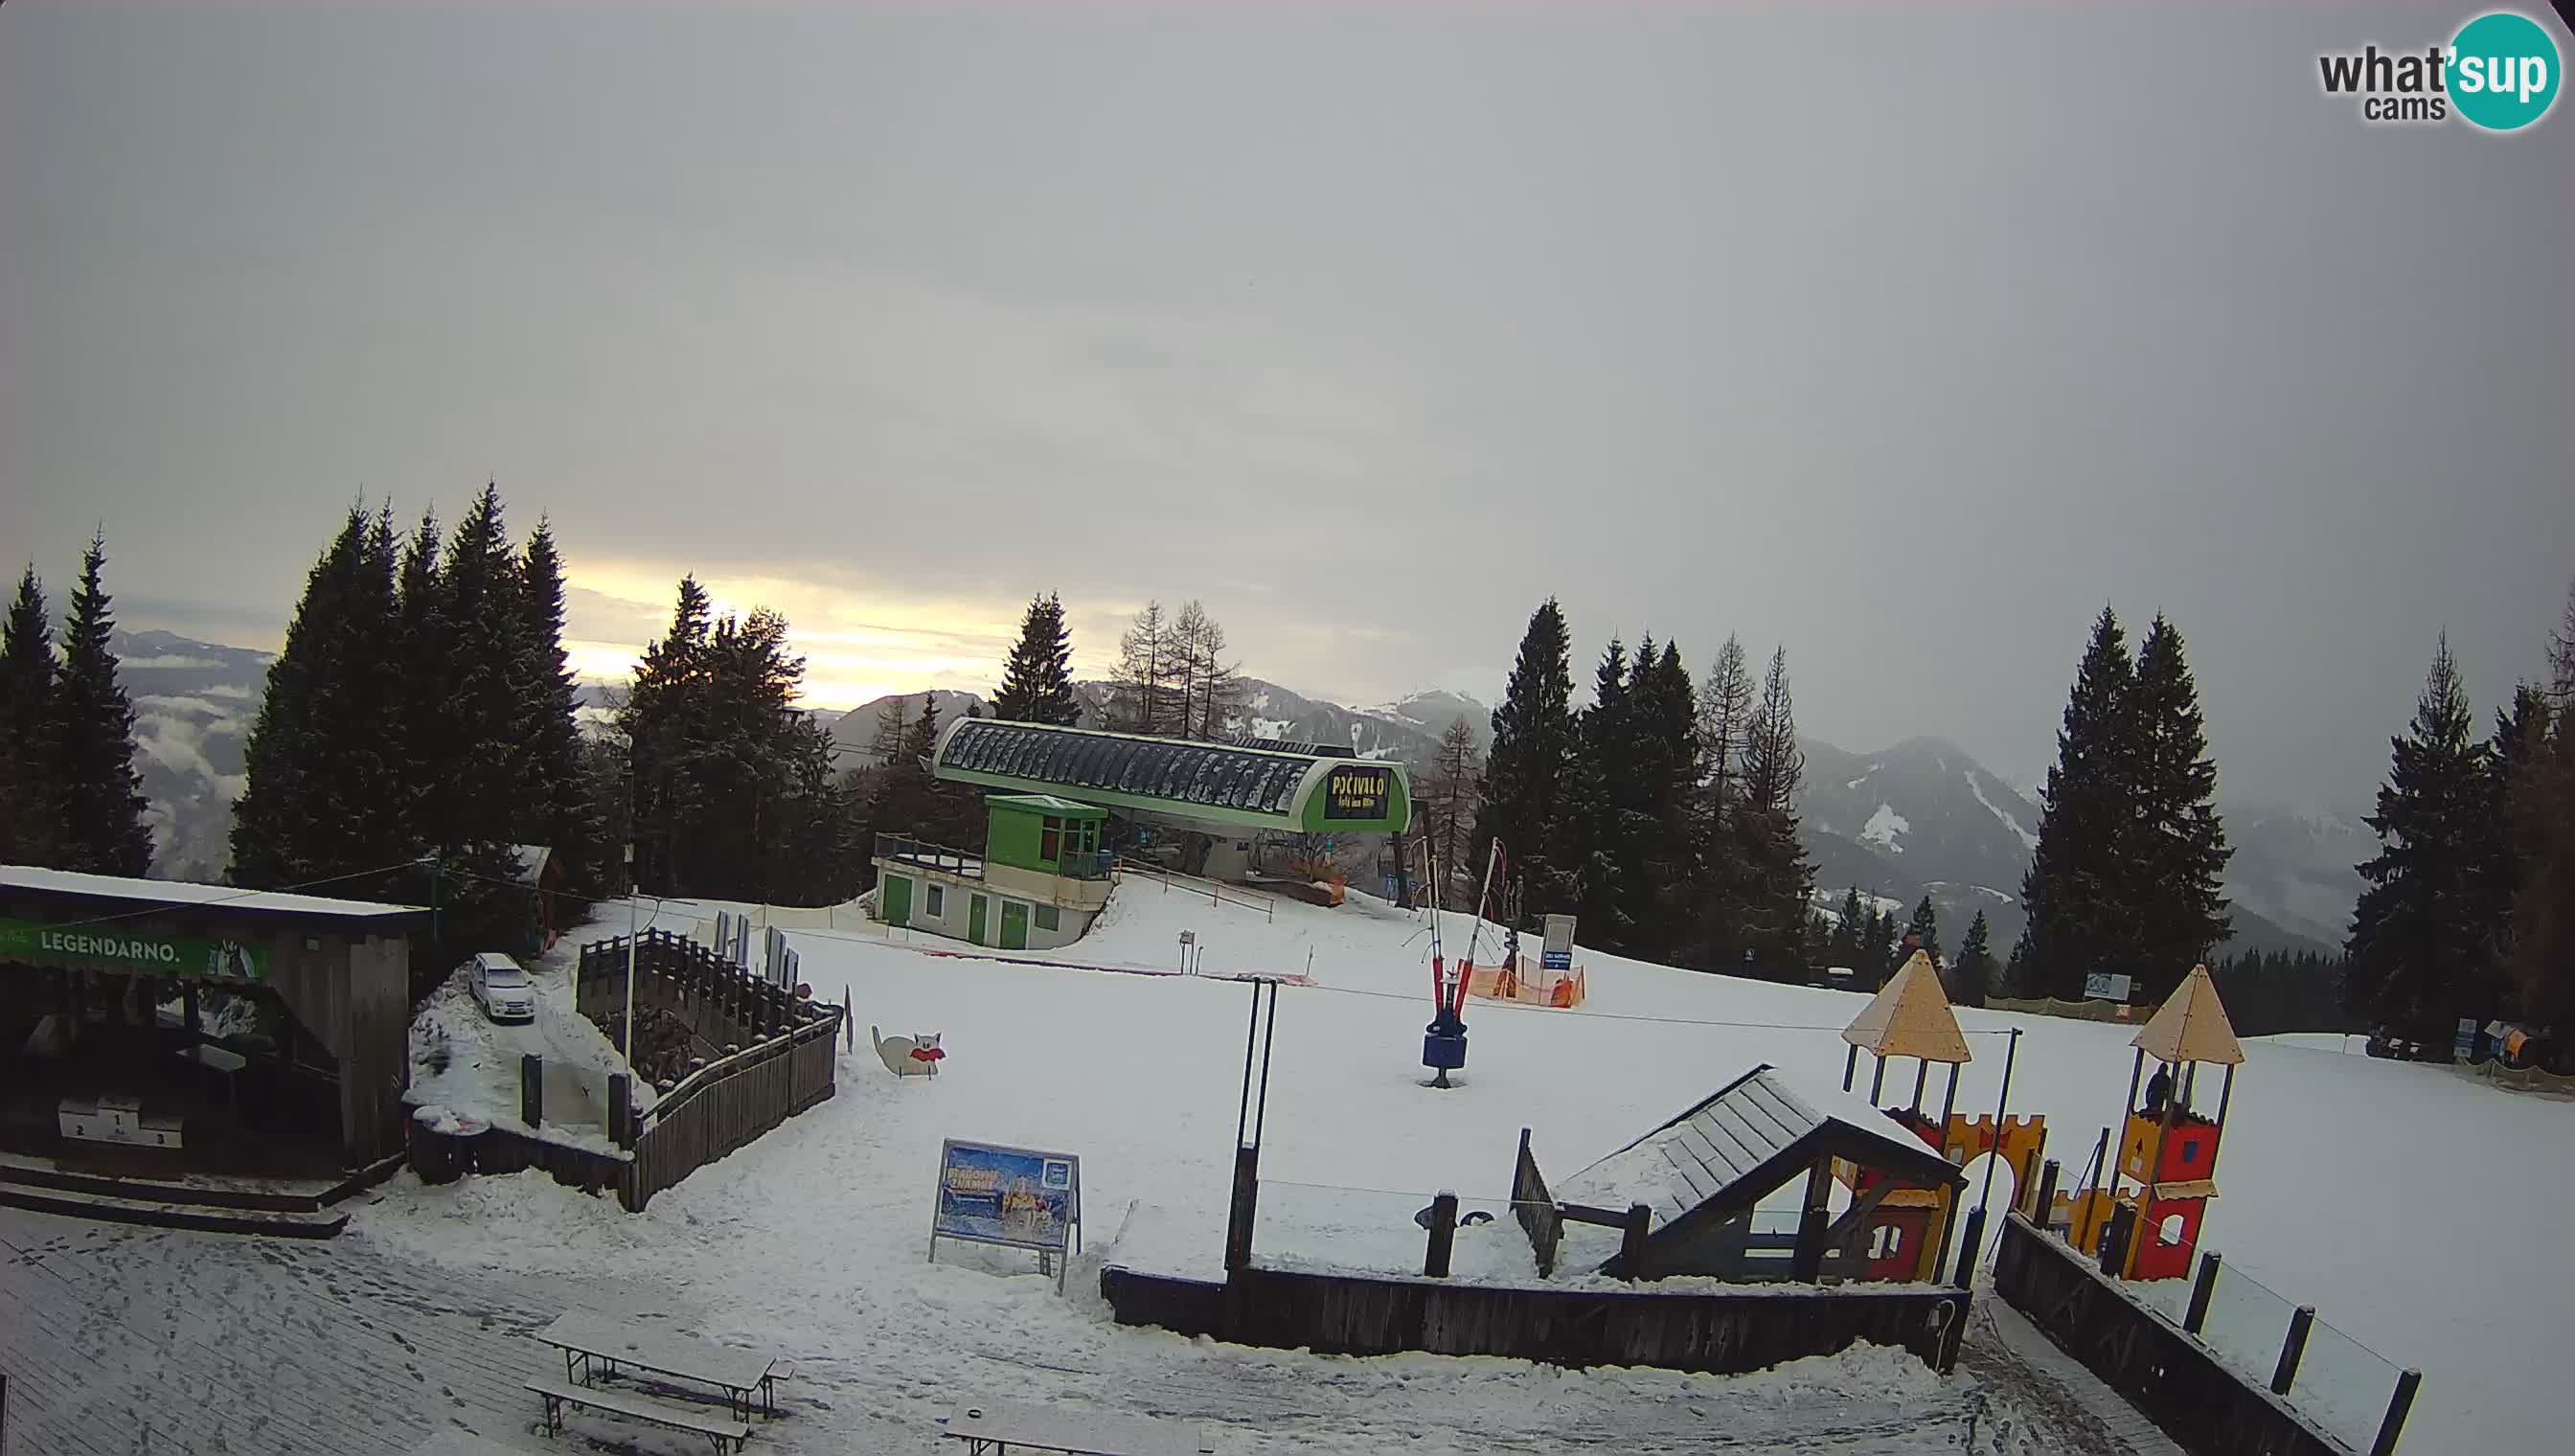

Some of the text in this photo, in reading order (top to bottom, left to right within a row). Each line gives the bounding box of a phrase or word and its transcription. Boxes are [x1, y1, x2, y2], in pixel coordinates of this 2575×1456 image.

[41, 931, 180, 963] LEGENDARNO.
[114, 1113, 121, 1126] 1
[76, 1125, 84, 1136] 2
[157, 1133, 165, 1145] 3
